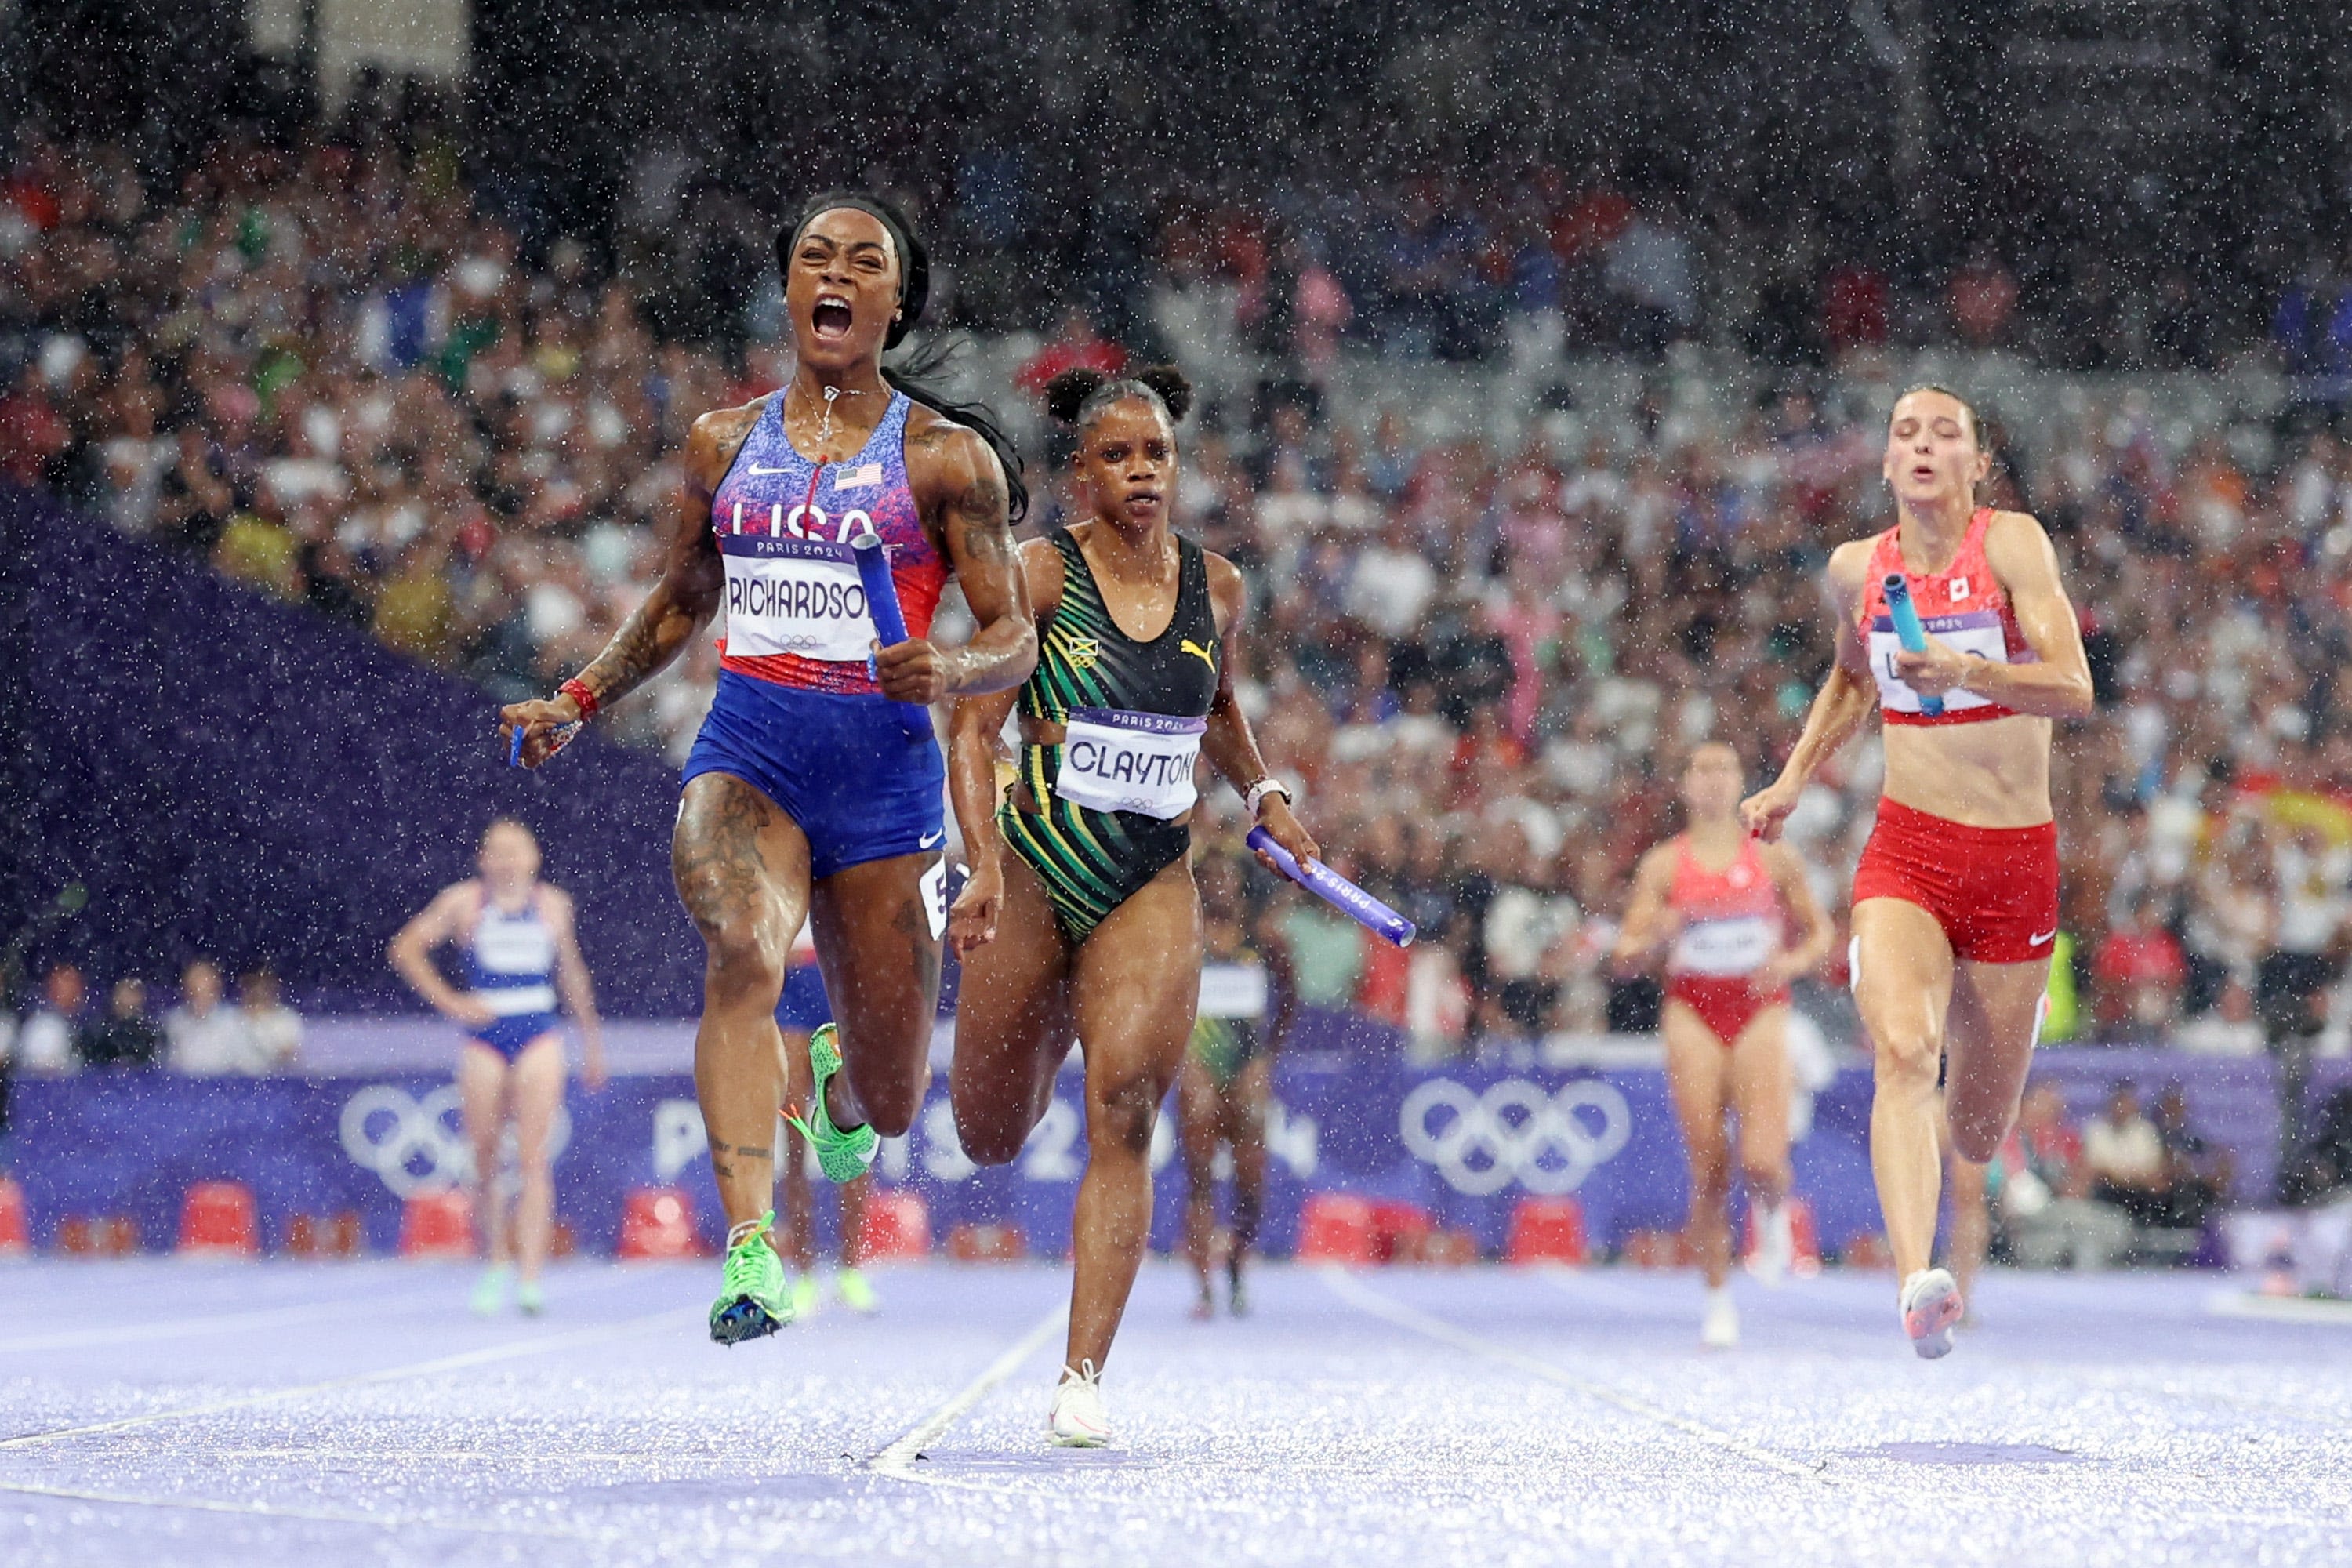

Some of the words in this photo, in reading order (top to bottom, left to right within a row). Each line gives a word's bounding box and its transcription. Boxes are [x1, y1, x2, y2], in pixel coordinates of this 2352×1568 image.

[757, 541, 799, 554] PARIS
[804, 546, 843, 557] 2024
[729, 577, 874, 619] RICHARDSO
[1112, 713, 1152, 728] PARIS
[1070, 741, 1196, 786] CLAYTON
[1327, 877, 1372, 909] PARIS
